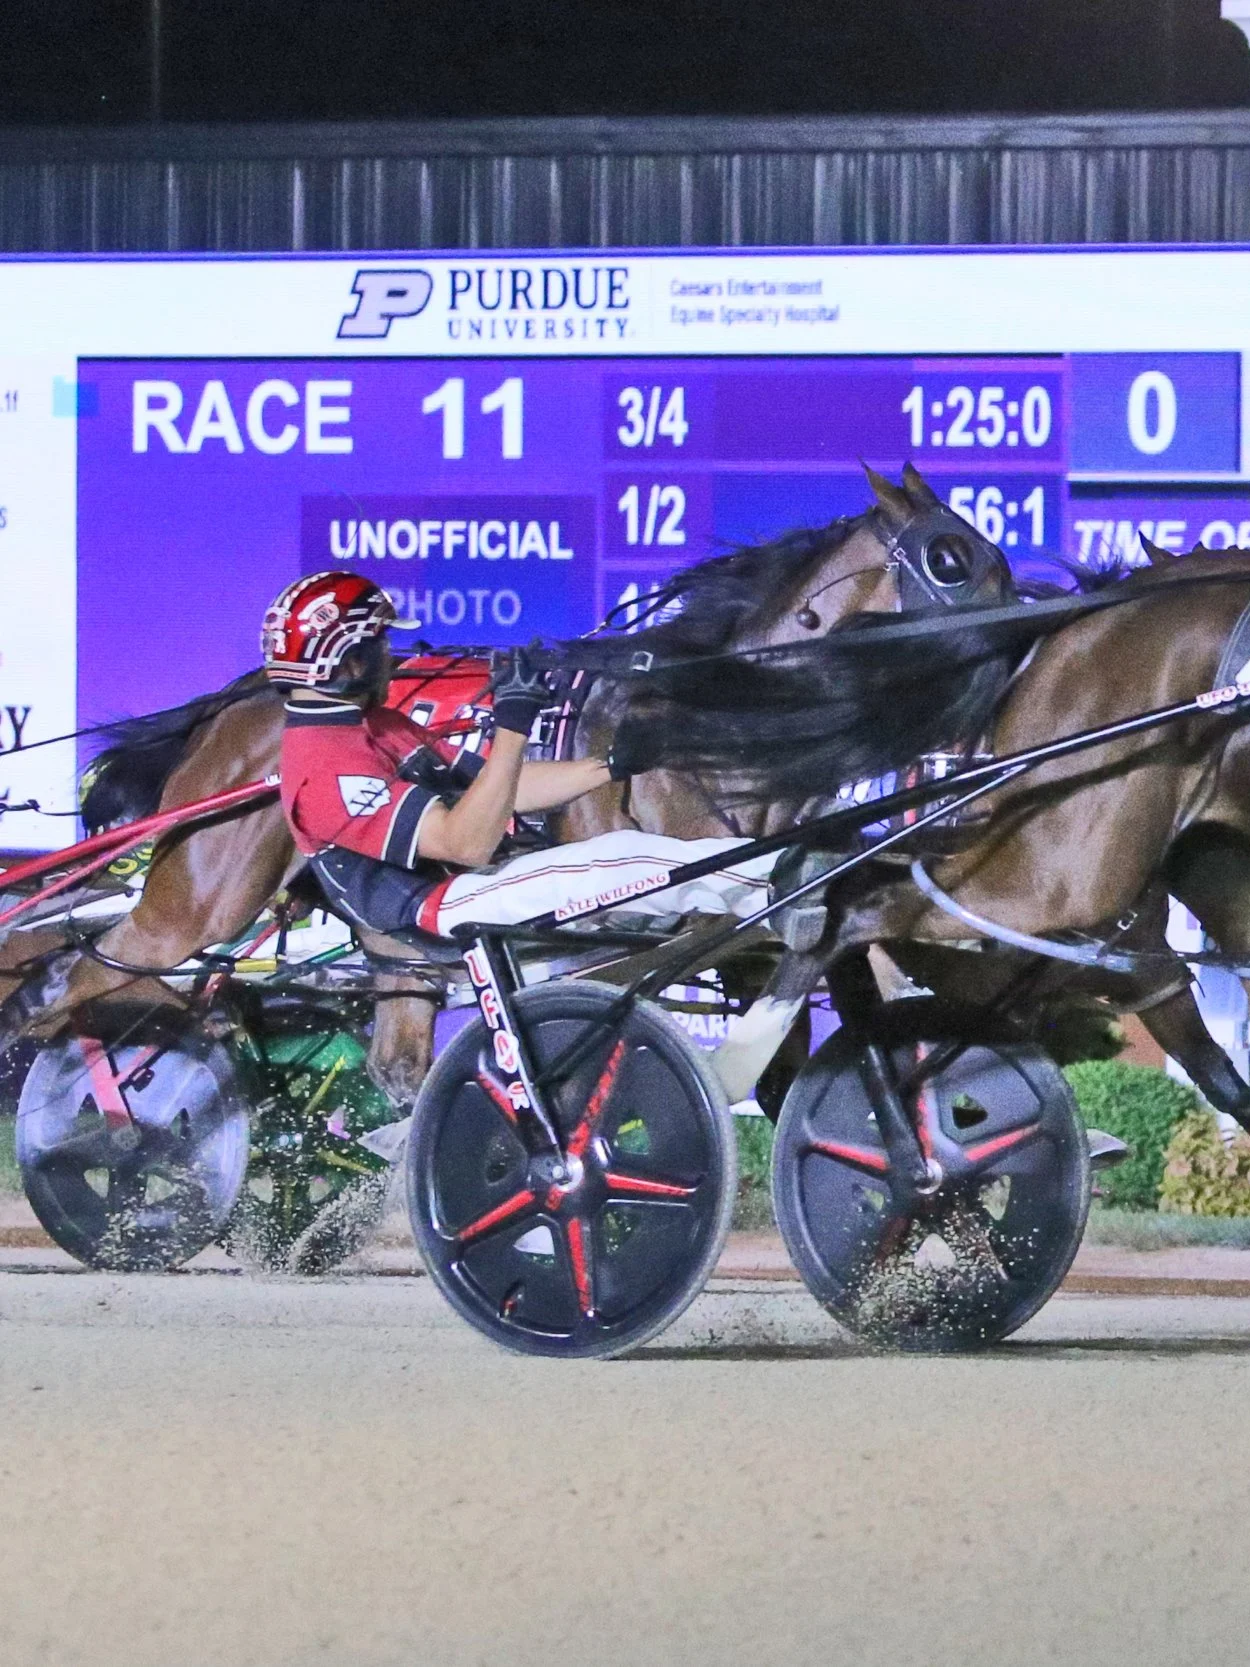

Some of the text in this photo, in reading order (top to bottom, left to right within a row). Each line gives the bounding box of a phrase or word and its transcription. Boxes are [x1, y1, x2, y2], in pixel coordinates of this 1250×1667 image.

[448, 267, 630, 311] PURDUE
[447, 317, 631, 340] UNIVERSITY
[131, 377, 525, 460] RACE 11
[617, 385, 689, 447] 3/4
[901, 386, 1052, 447] 1:25:0
[1126, 370, 1178, 455] 0
[329, 520, 574, 560] UNOFFICIAL
[617, 484, 687, 546] 1/2
[557, 873, 667, 919] KYLE WILFONG
